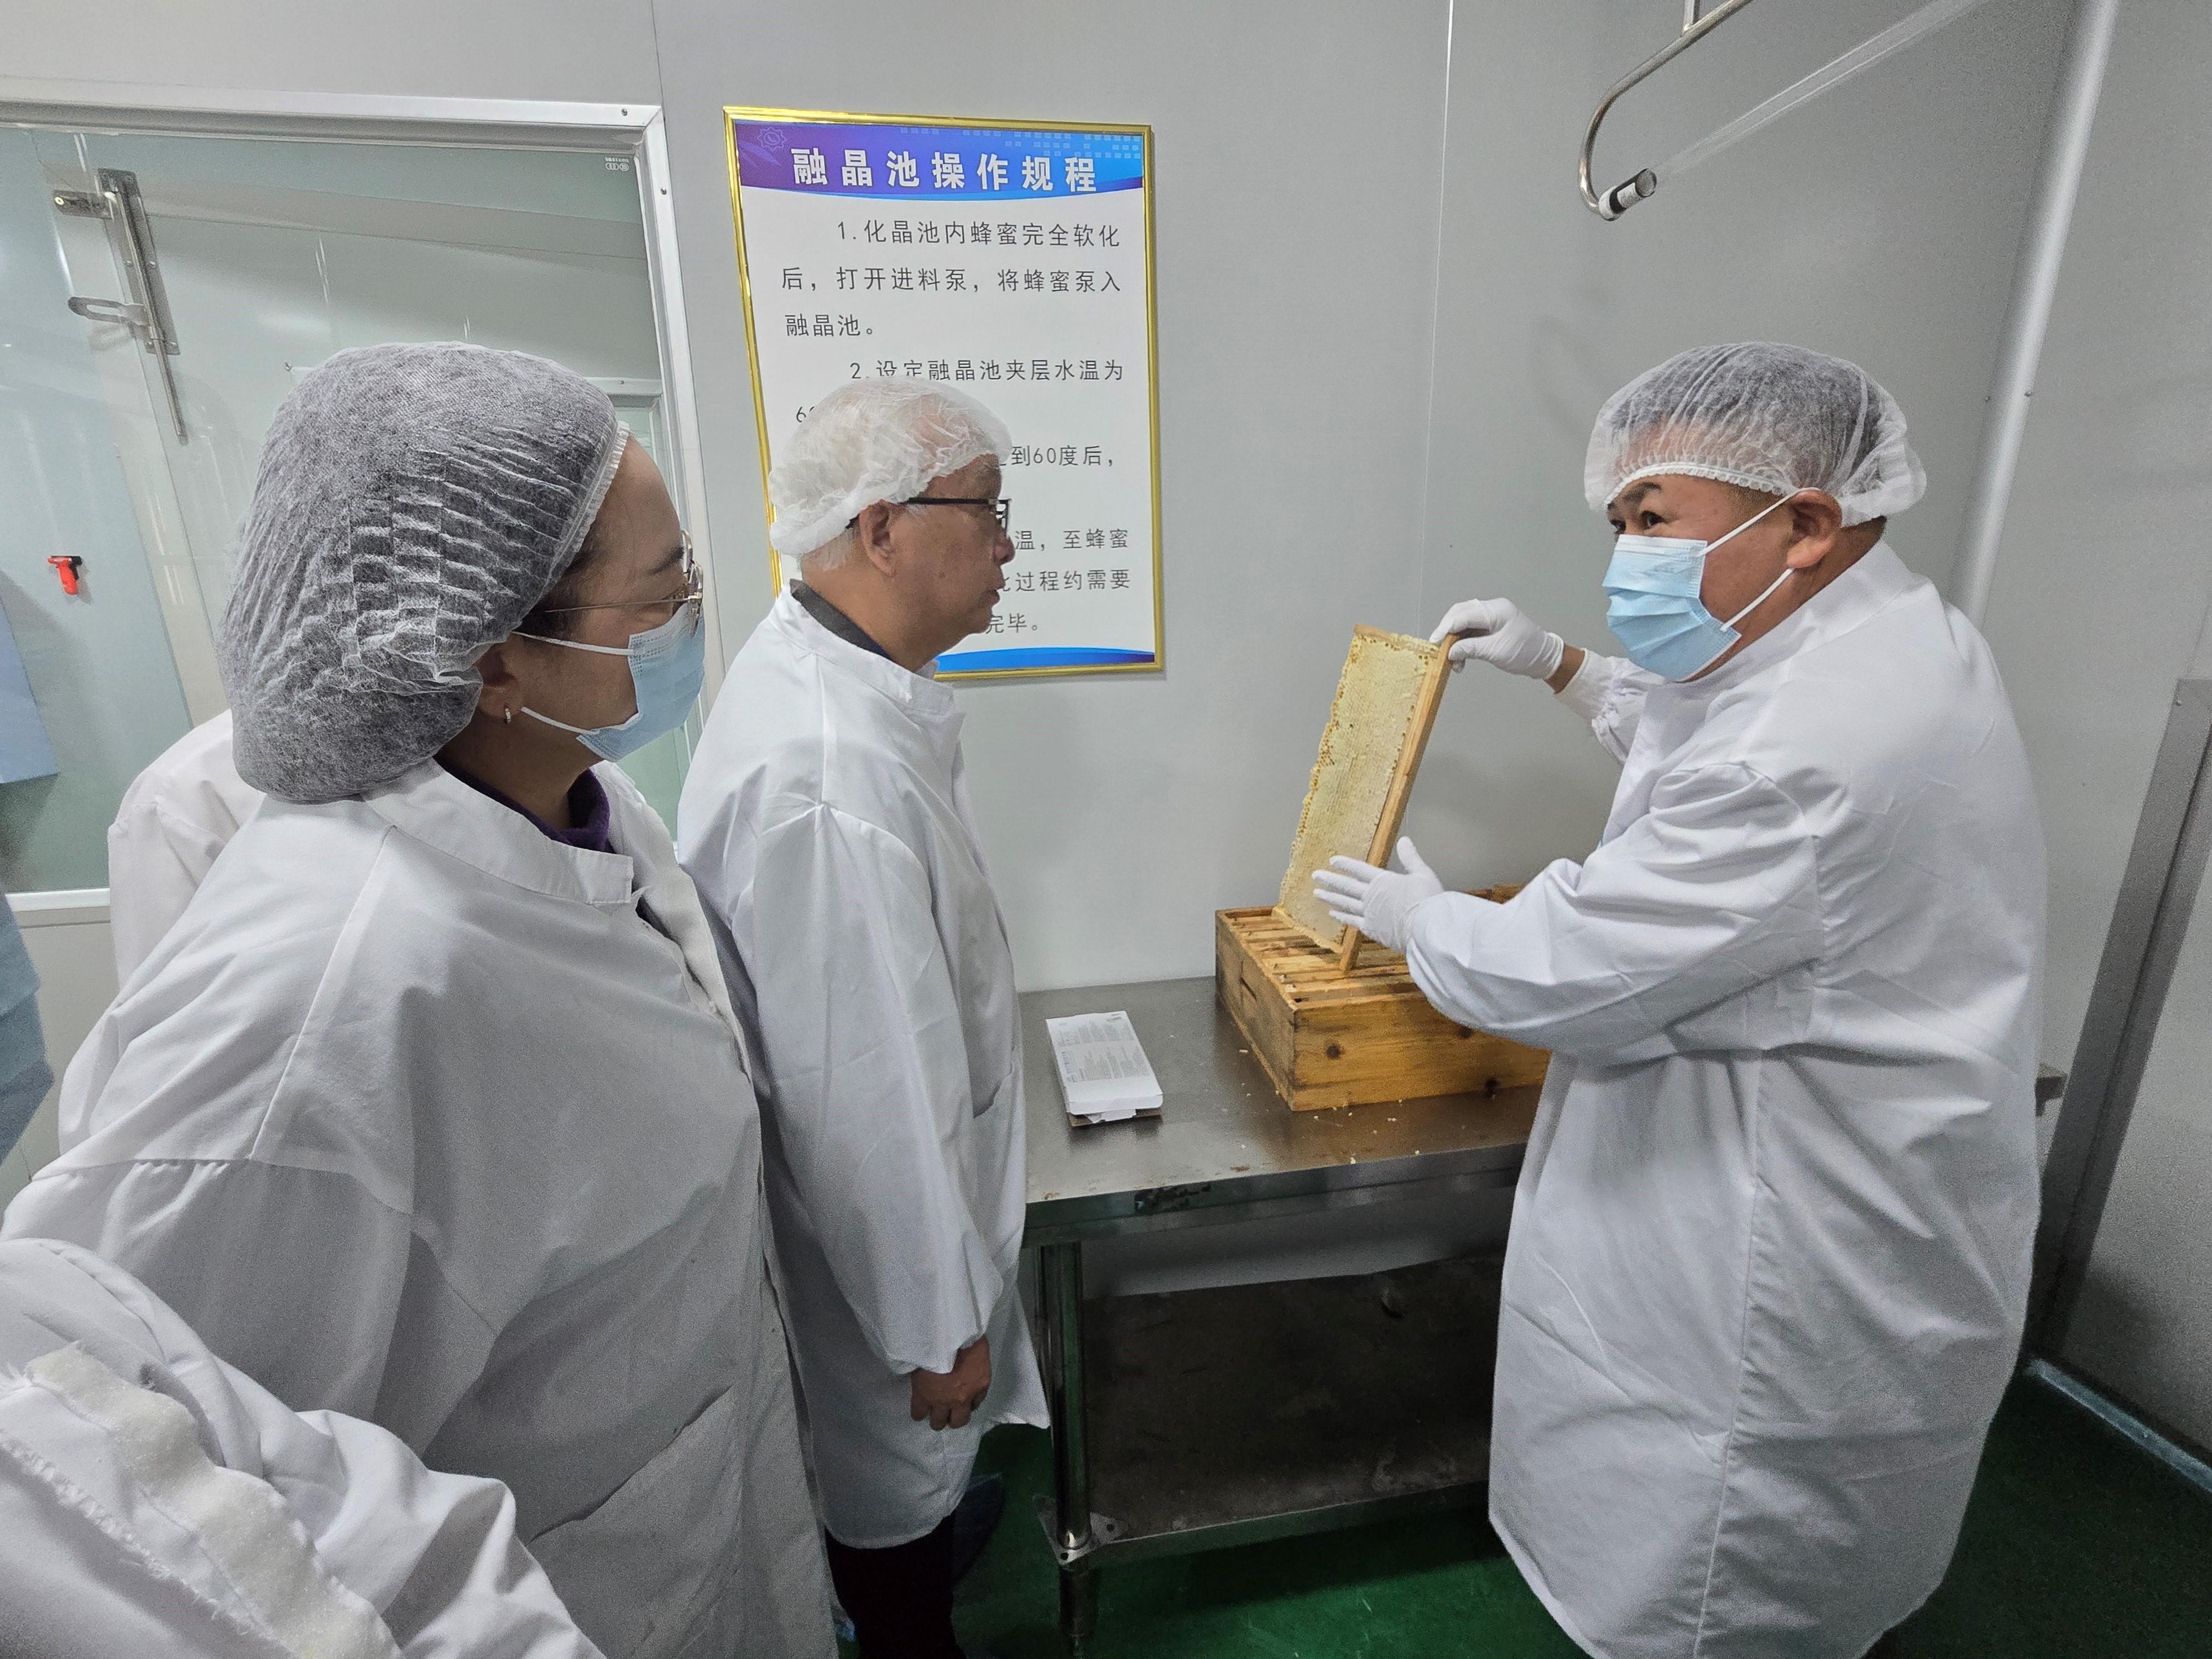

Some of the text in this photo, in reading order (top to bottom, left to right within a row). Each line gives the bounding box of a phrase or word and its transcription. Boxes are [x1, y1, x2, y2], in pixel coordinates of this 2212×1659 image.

[790, 147, 1097, 193] 融晶池操作规程
[837, 219, 1120, 248] 1.化晶池内蜂蜜完全软化
[782, 266, 1120, 293] 后，打开进料泵，将蜂蜜泵入
[784, 313, 873, 337] 融晶池。
[999, 445, 1113, 467] 到60度后，
[985, 613, 1038, 634] 完毕。
